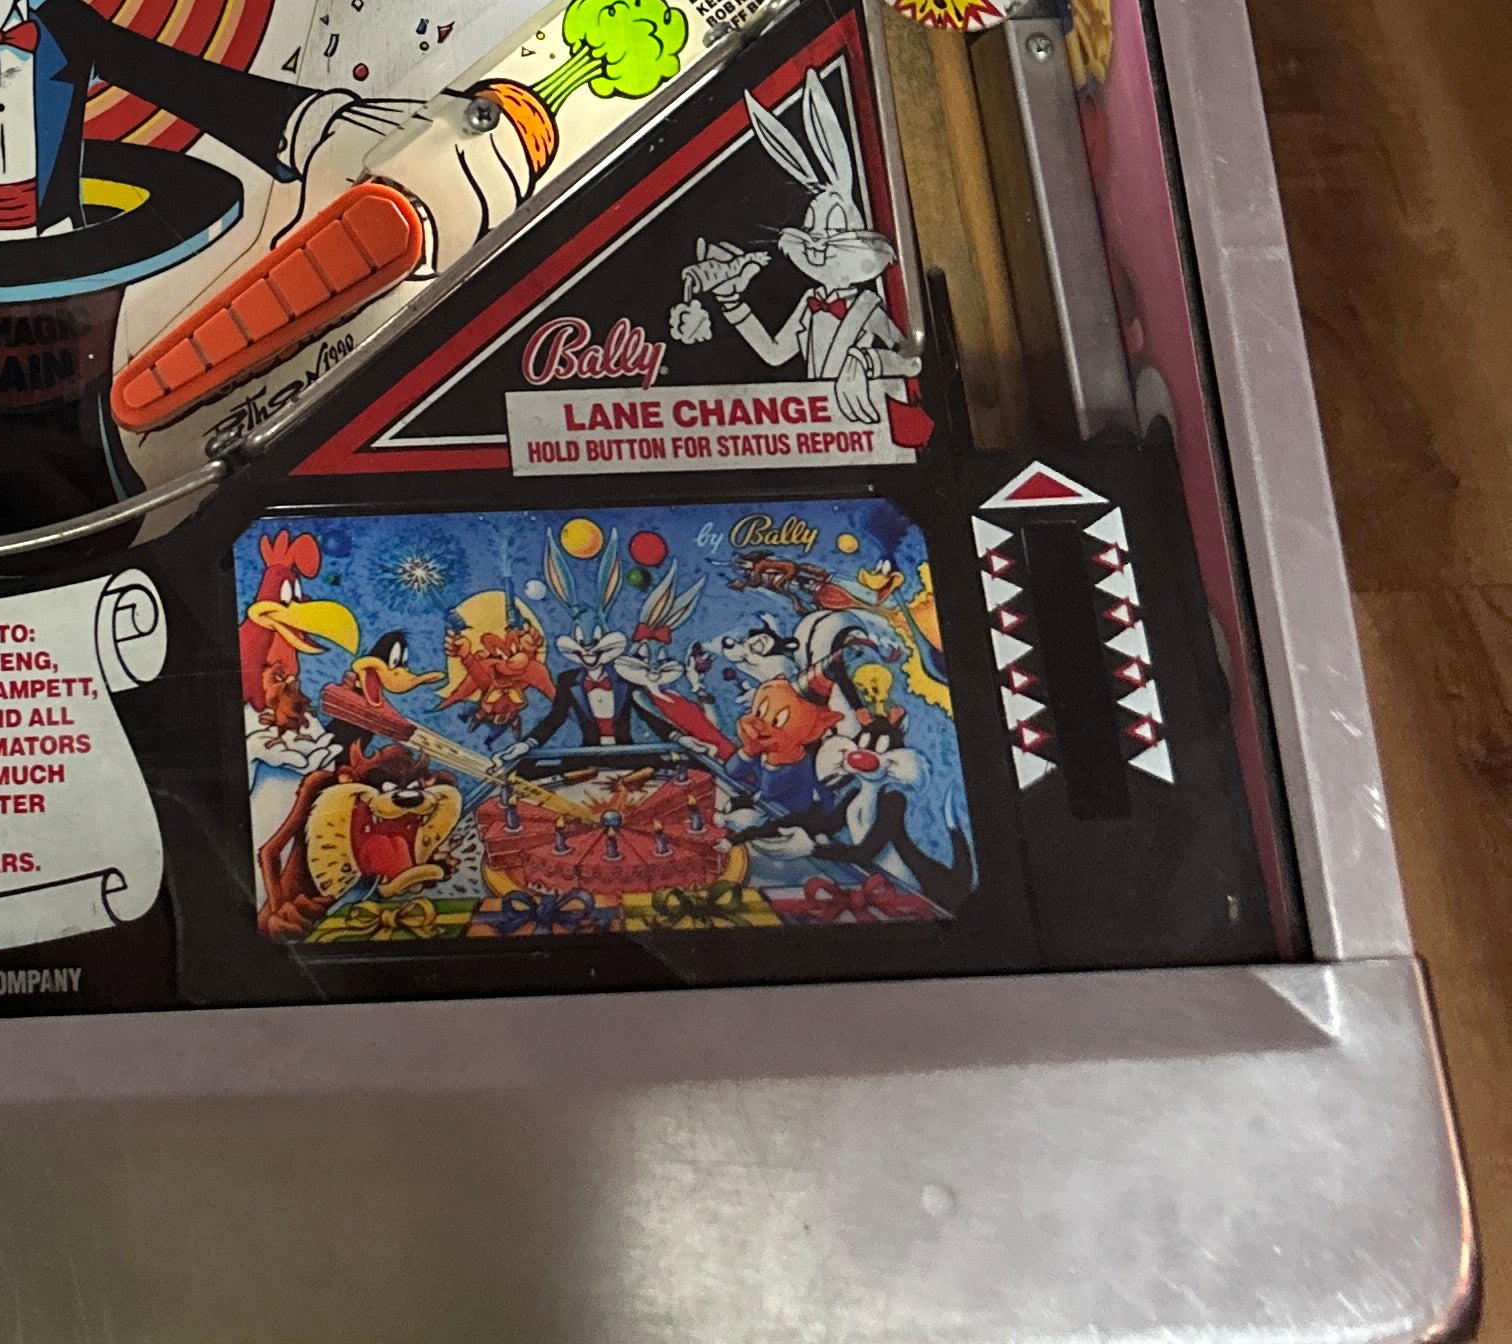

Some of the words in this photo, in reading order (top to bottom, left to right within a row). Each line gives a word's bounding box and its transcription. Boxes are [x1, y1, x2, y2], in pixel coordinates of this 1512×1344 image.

[522, 317, 666, 390] Bally
[563, 401, 664, 431] LANE
[672, 396, 831, 427] CHANGE
[528, 441, 580, 463] HOLD
[587, 437, 666, 460] BUTTON
[672, 436, 712, 458] FOR
[717, 434, 791, 456] STATUS
[798, 430, 875, 454] REPORT
[693, 522, 724, 555] by
[729, 513, 819, 554] Bally
[29, 707, 74, 726] ALL
